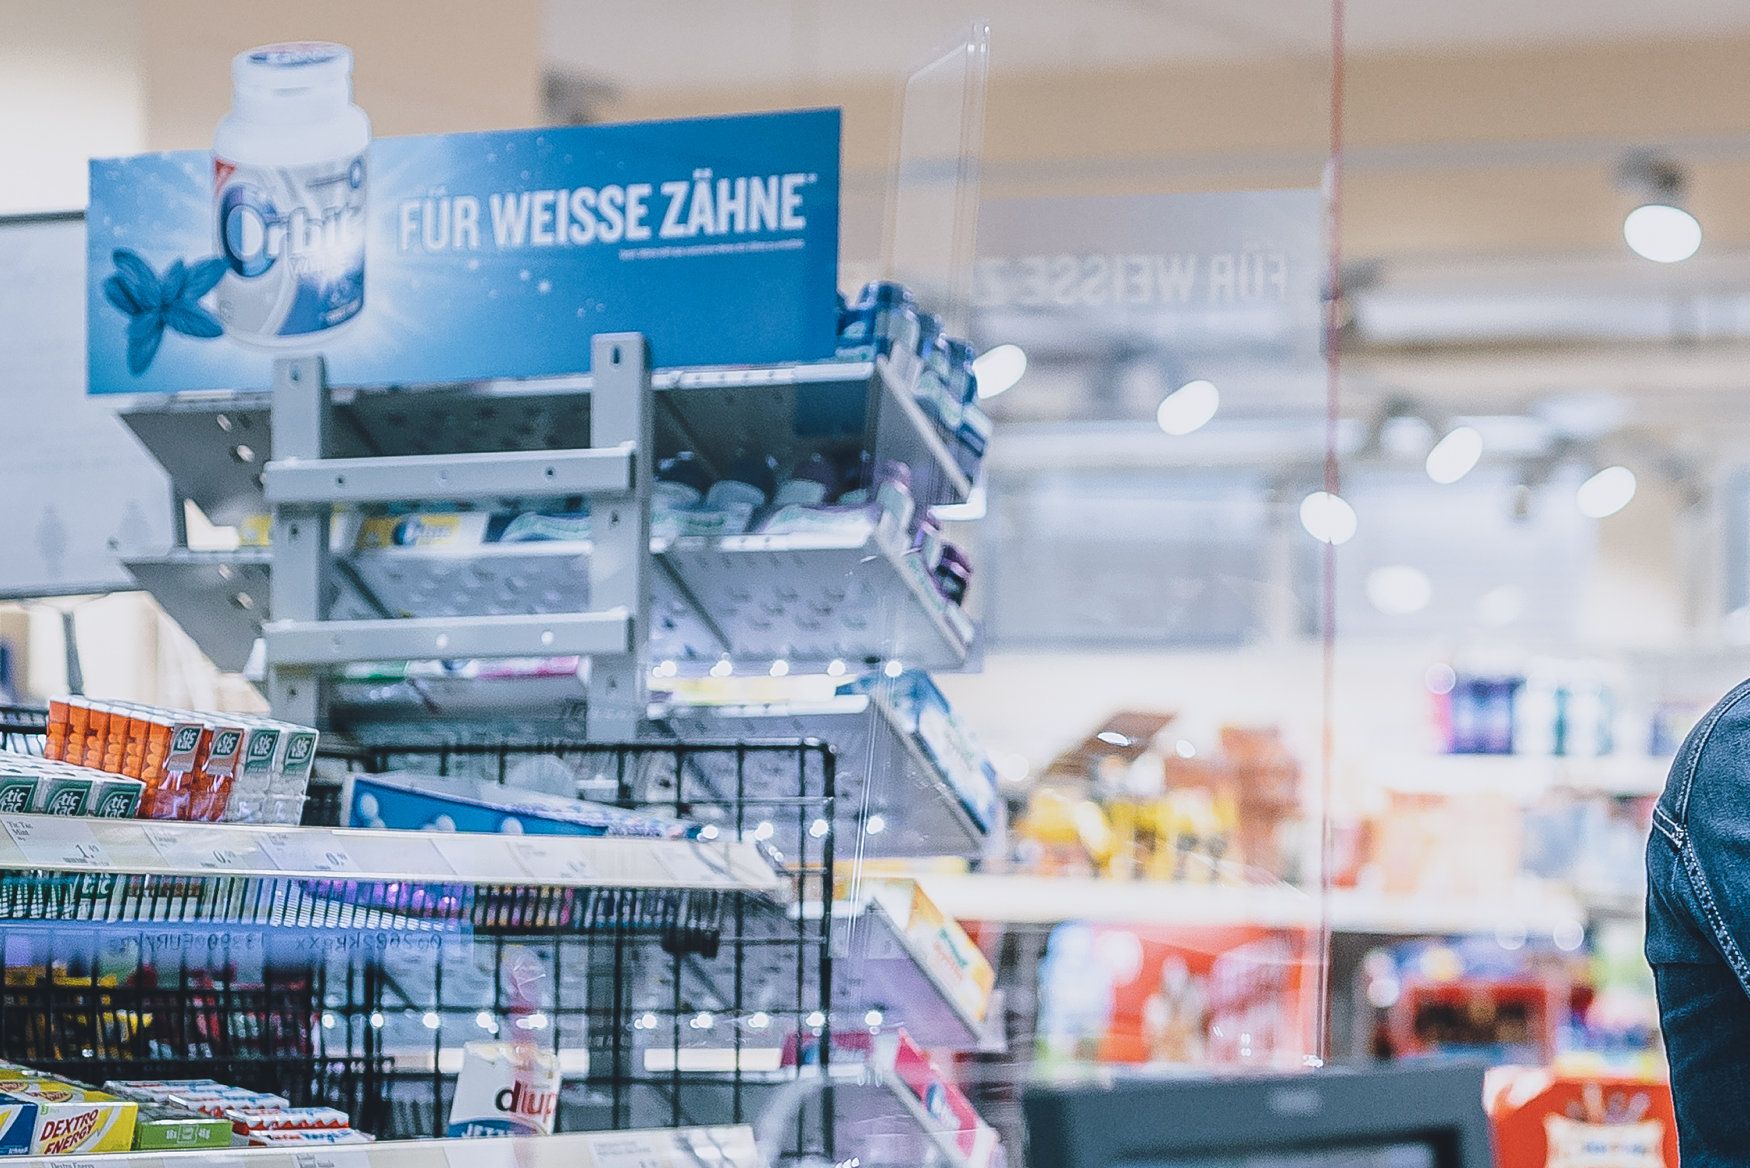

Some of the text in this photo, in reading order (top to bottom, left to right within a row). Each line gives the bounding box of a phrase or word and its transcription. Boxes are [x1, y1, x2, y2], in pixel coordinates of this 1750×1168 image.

[395, 186, 480, 252] FÜR
[490, 183, 653, 246] WEISSE
[39, 1108, 99, 1142] DEXTRO
[44, 1120, 97, 1154] ENERGY
